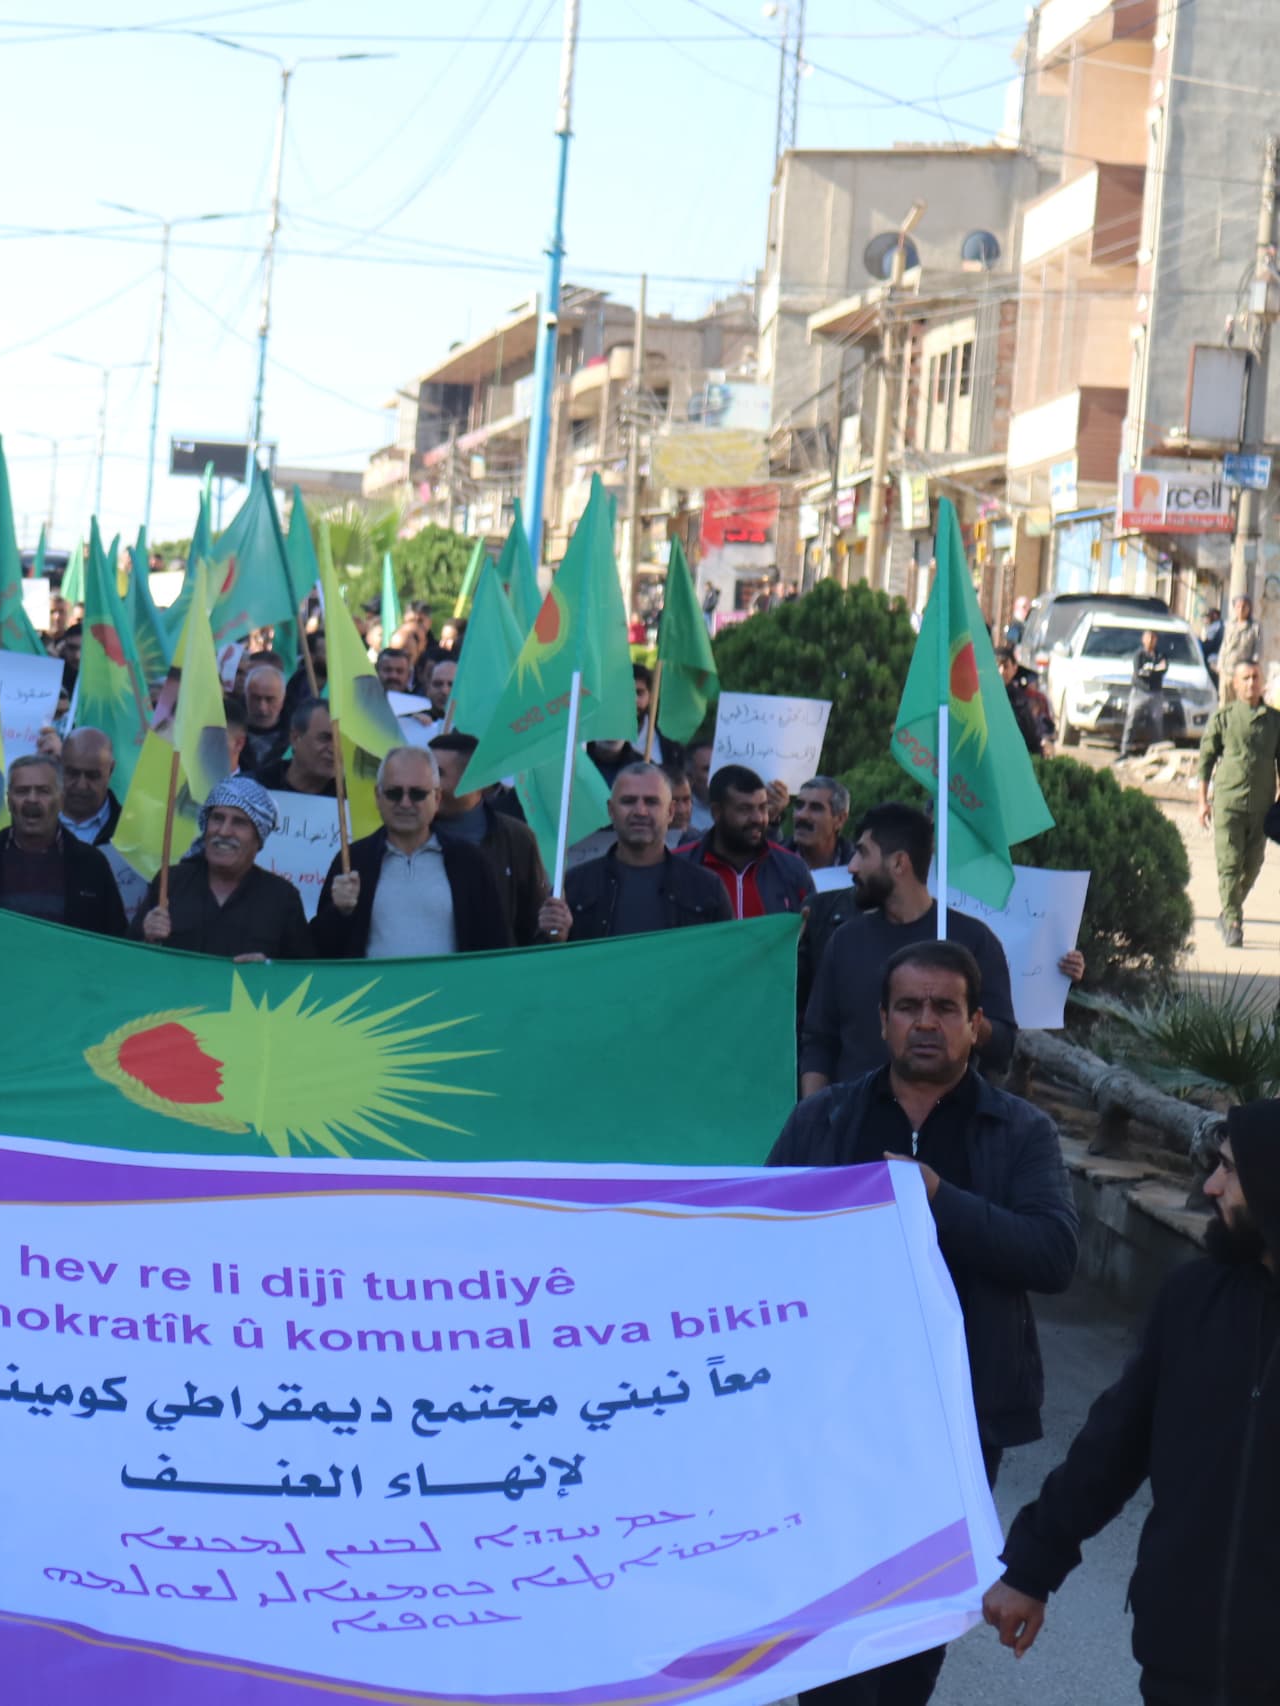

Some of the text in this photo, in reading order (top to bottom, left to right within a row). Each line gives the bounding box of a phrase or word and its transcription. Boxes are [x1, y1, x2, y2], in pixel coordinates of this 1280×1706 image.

[20, 1244, 118, 1285] hev
[140, 1265, 191, 1291] re
[212, 1262, 239, 1294] li
[261, 1267, 345, 1307] dijî
[363, 1267, 575, 1307] tundiyê
[233, 1318, 264, 1349] û
[286, 1318, 531, 1352] komunal
[553, 1322, 650, 1348] ava
[671, 1300, 808, 1339] bikin
[146, 1381, 392, 1435] ديمقراطي
[411, 1384, 558, 1438] مجتمع
[580, 1370, 690, 1432] نبني
